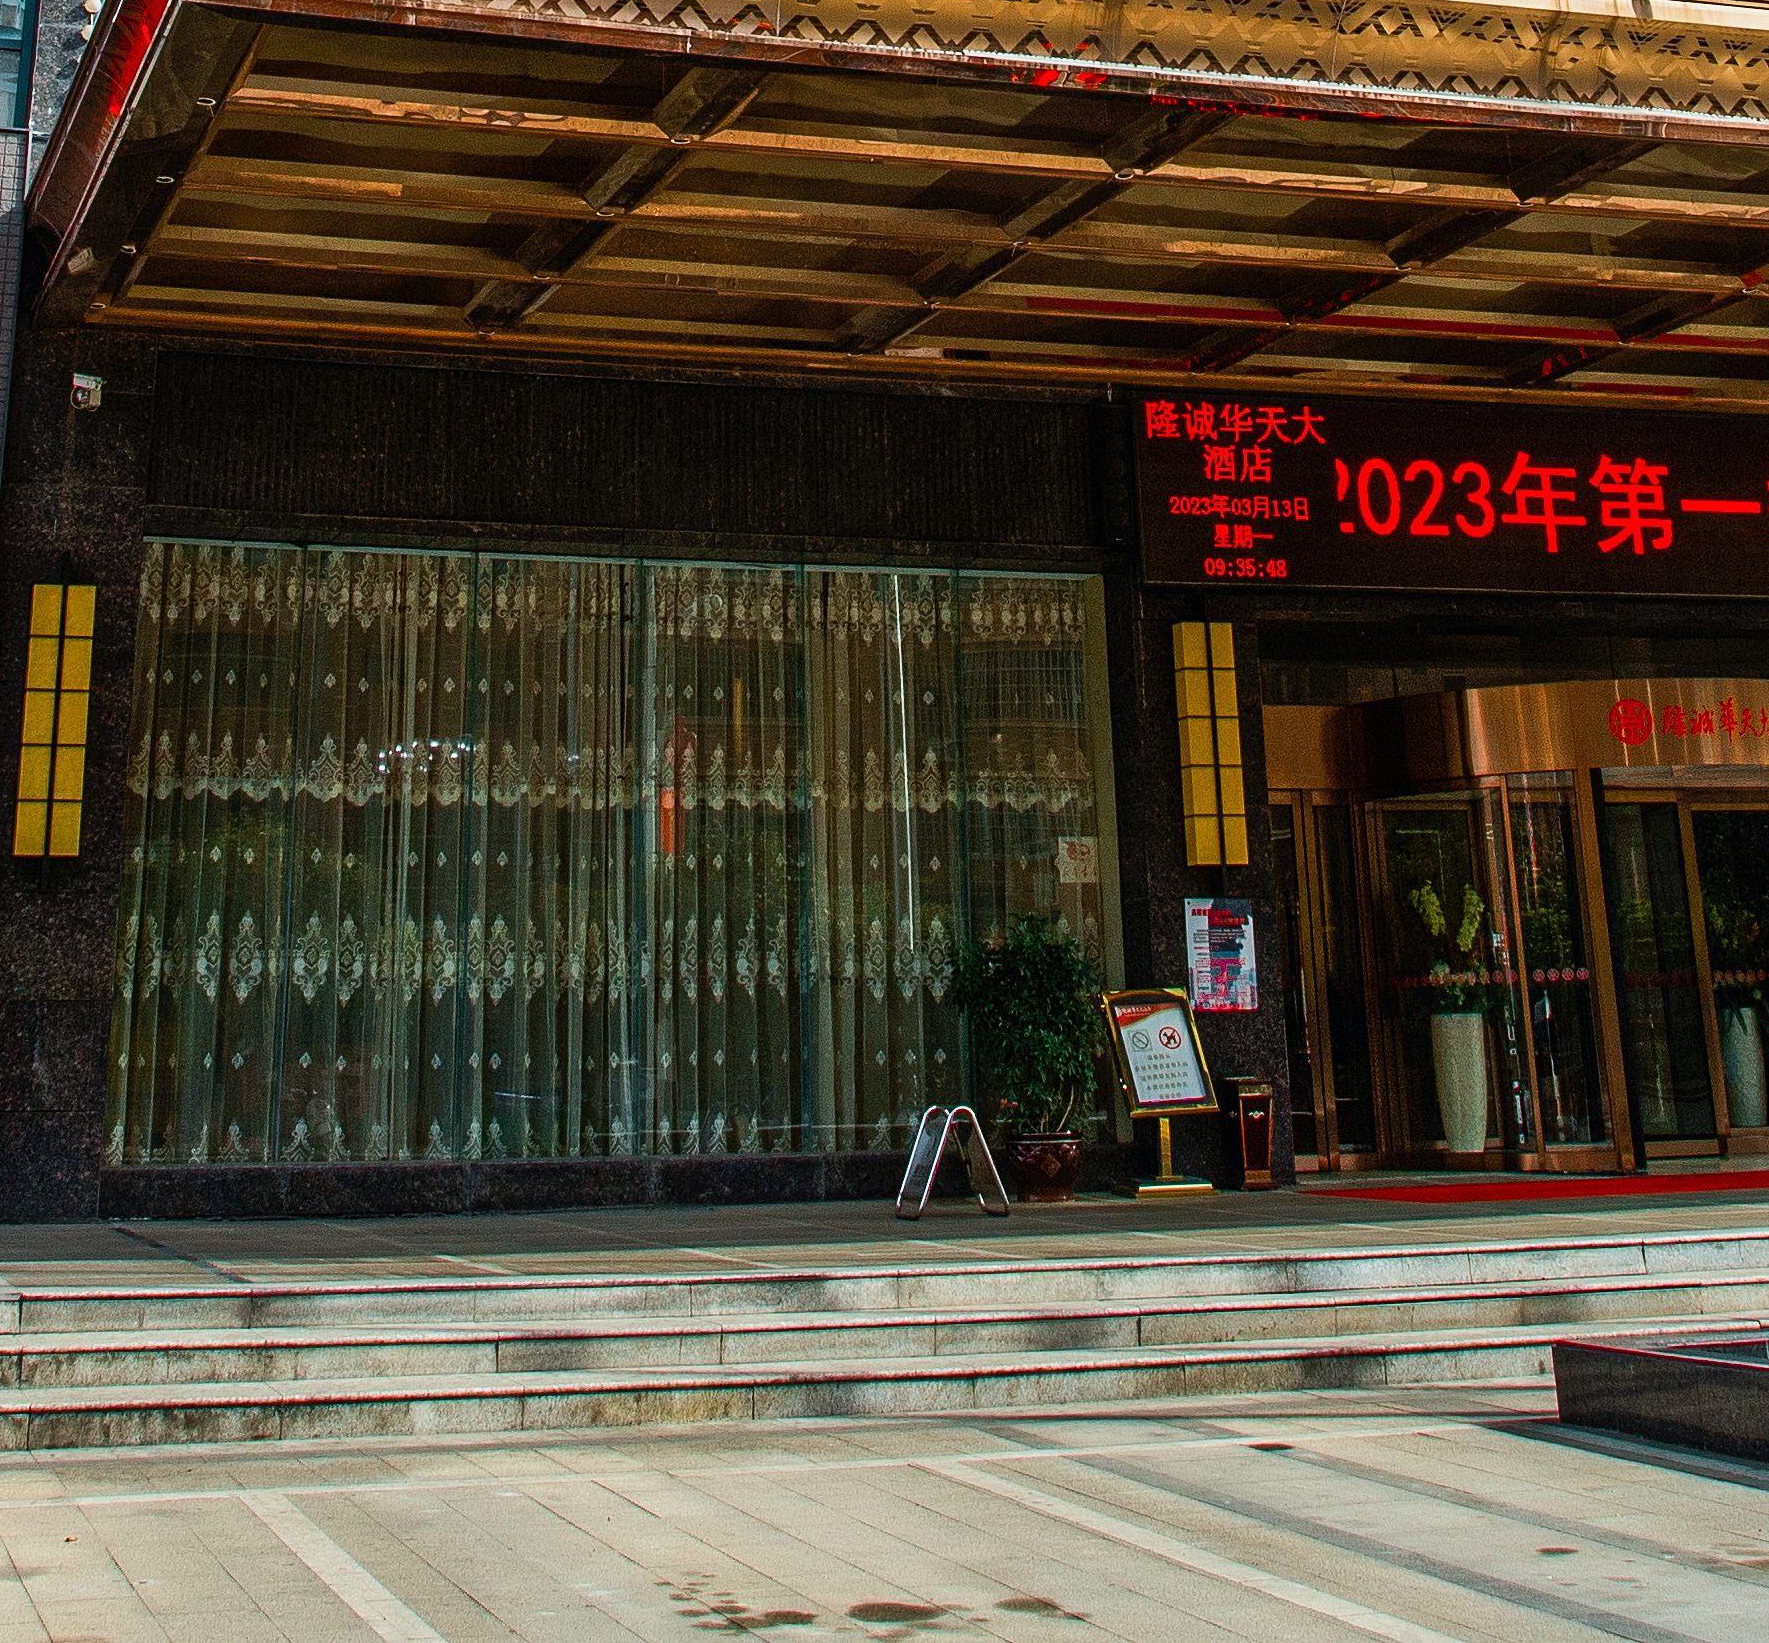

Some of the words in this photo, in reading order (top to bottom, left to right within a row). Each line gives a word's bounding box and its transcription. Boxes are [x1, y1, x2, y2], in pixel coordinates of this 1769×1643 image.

[1145, 400, 1327, 445] 隆诚华天大
[1203, 444, 1273, 484] 酒店
[1169, 494, 1310, 521] 2023年03月13日
[1213, 525, 1274, 549] 星期一
[1204, 557, 1288, 578] 09:35:48
